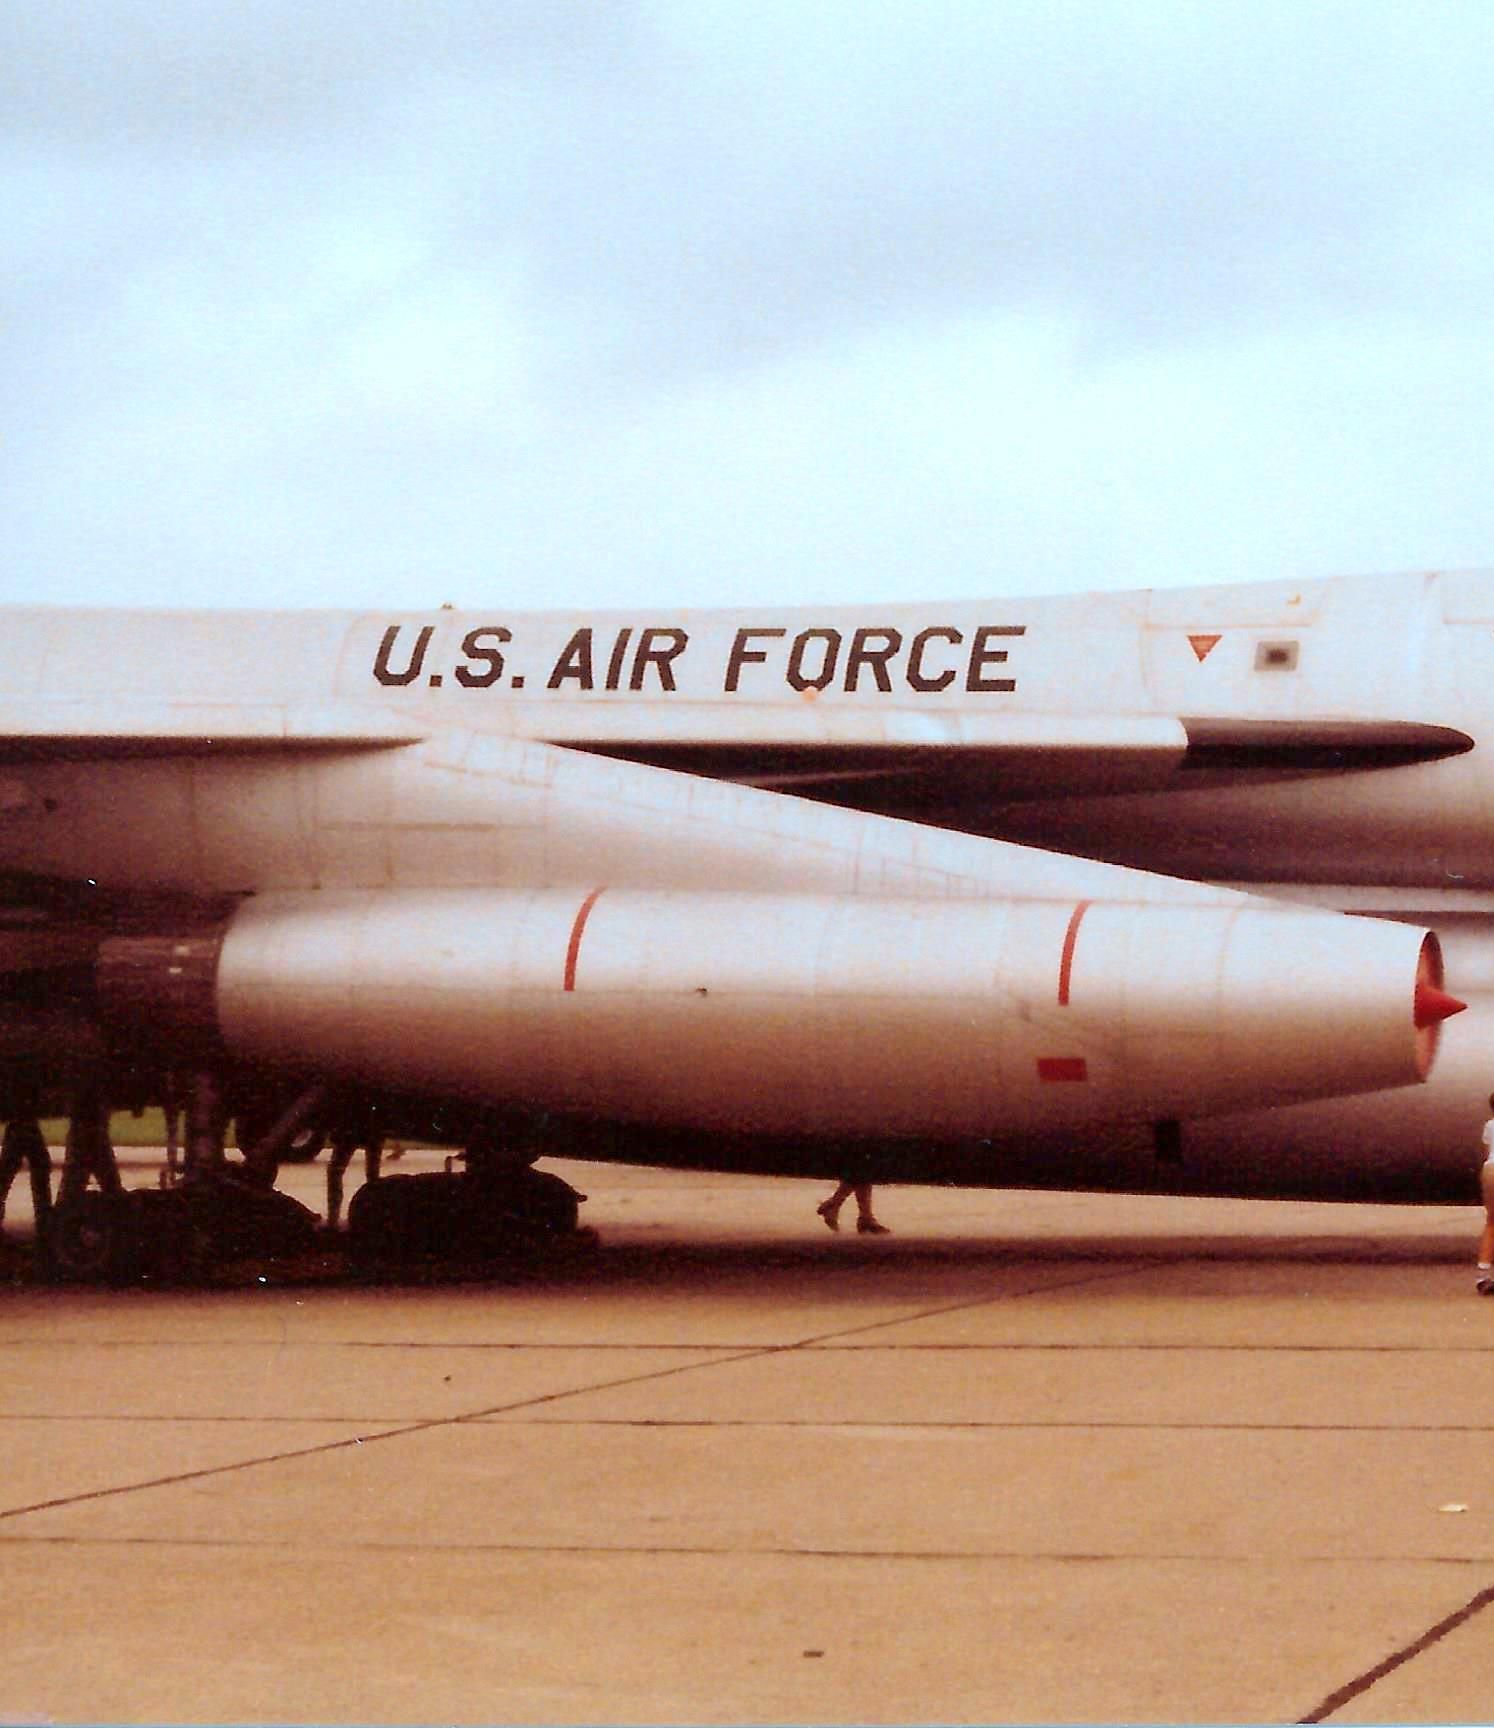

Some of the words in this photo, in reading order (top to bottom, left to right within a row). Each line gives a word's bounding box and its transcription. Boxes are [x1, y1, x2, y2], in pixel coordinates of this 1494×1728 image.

[372, 625, 524, 689] U.S.
[546, 626, 689, 691] AIR
[725, 625, 1027, 693] FORCE
